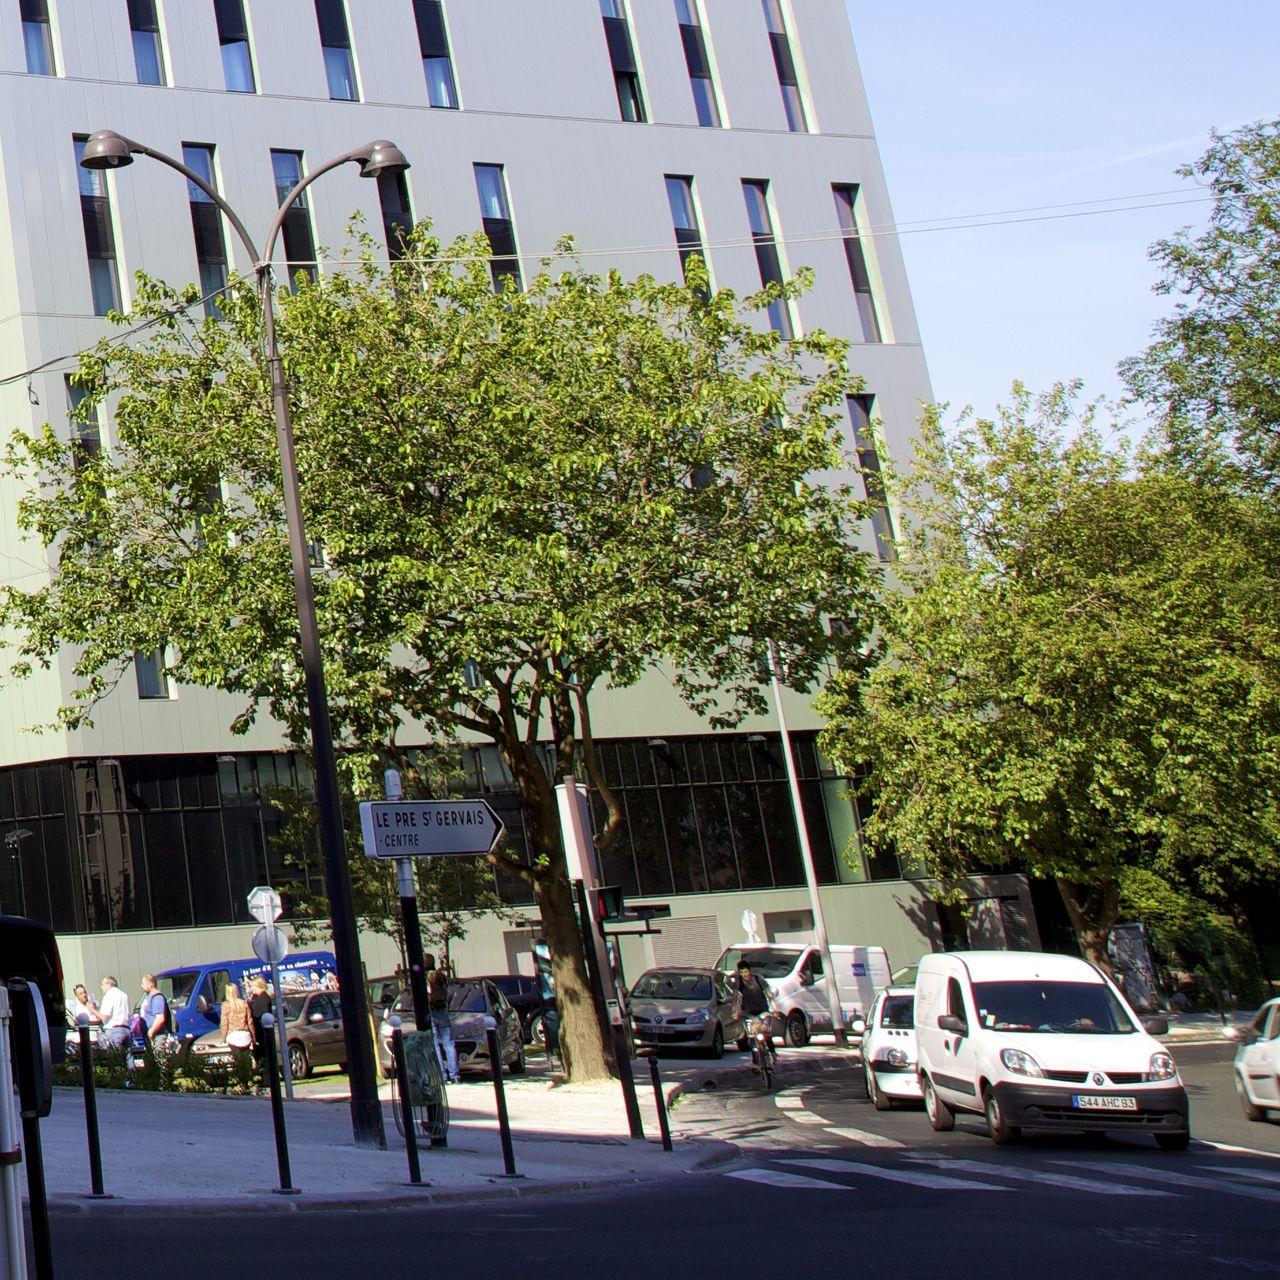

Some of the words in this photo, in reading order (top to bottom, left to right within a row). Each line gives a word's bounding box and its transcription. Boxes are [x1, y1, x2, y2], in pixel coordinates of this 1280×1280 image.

[376, 812, 390, 828] LE
[396, 811, 417, 827] PRE
[436, 810, 484, 826] GERVAIS
[1080, 1097, 1099, 1107] 544
[1101, 1098, 1120, 1108] AHC
